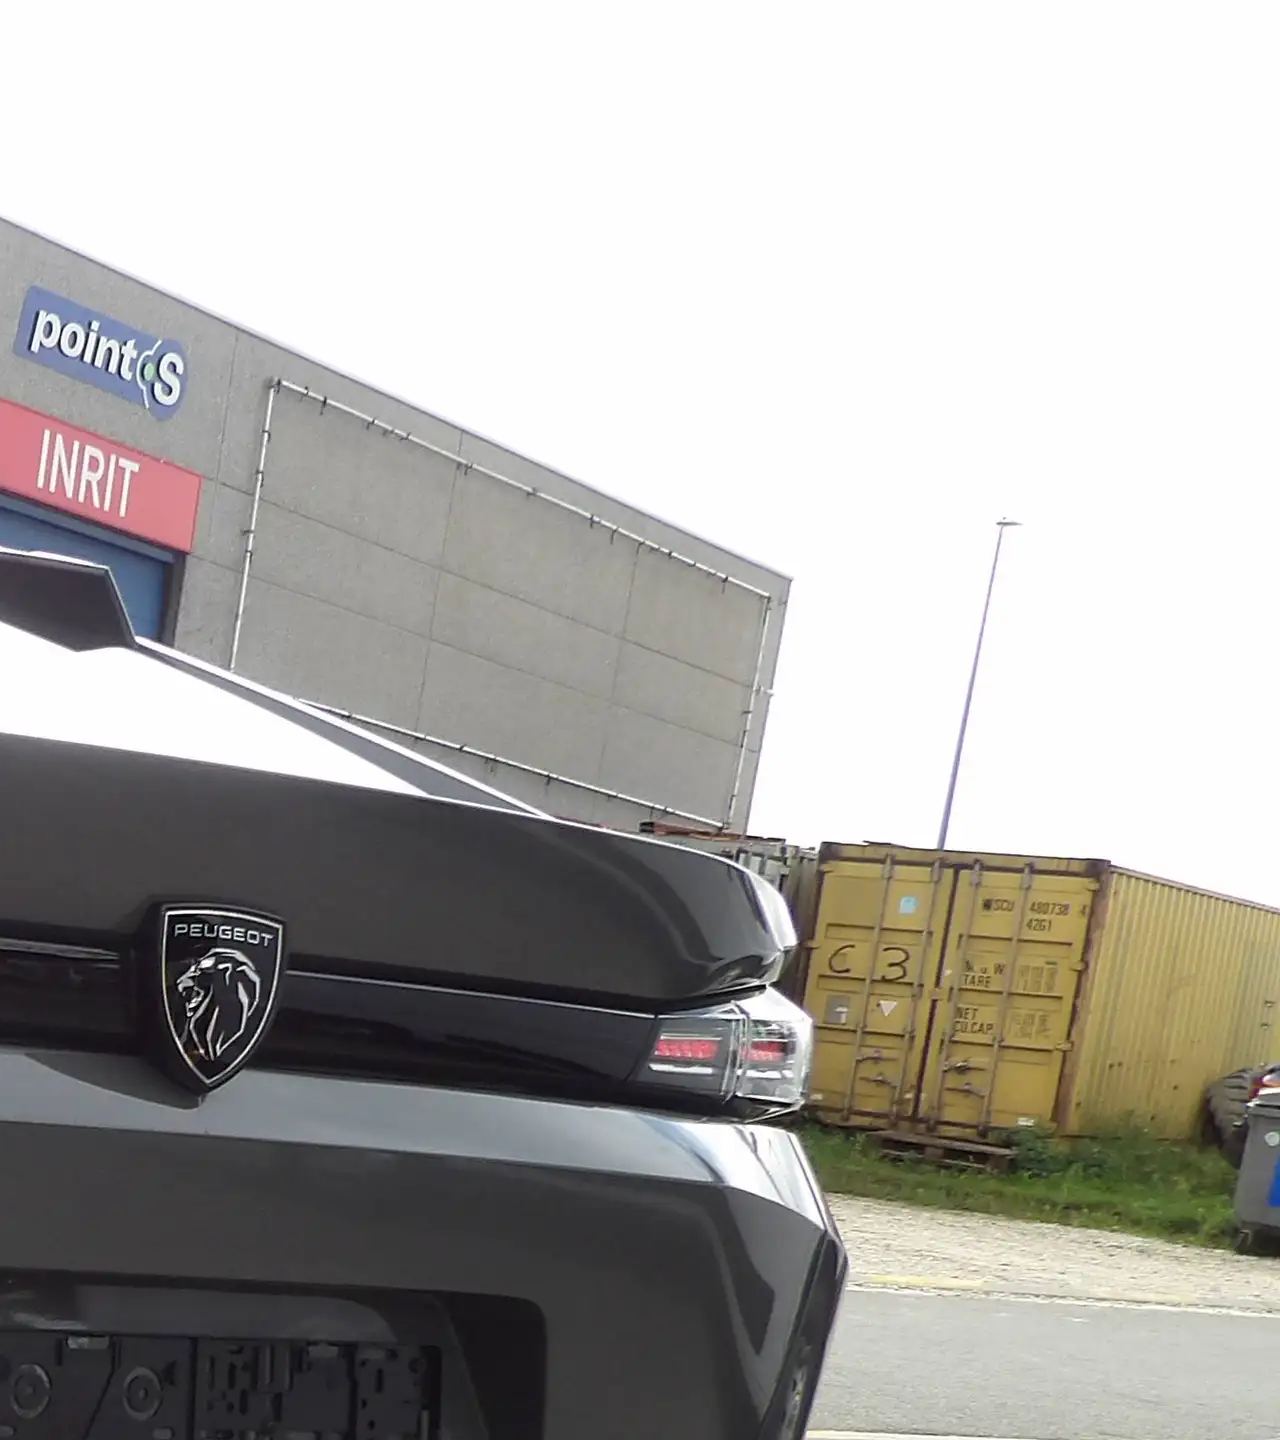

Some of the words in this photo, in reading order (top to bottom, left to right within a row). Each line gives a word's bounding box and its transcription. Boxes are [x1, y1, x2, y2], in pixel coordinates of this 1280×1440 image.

[29, 309, 138, 382] point
[36, 428, 141, 519] INRIT
[174, 923, 276, 948] PEUGEOT
